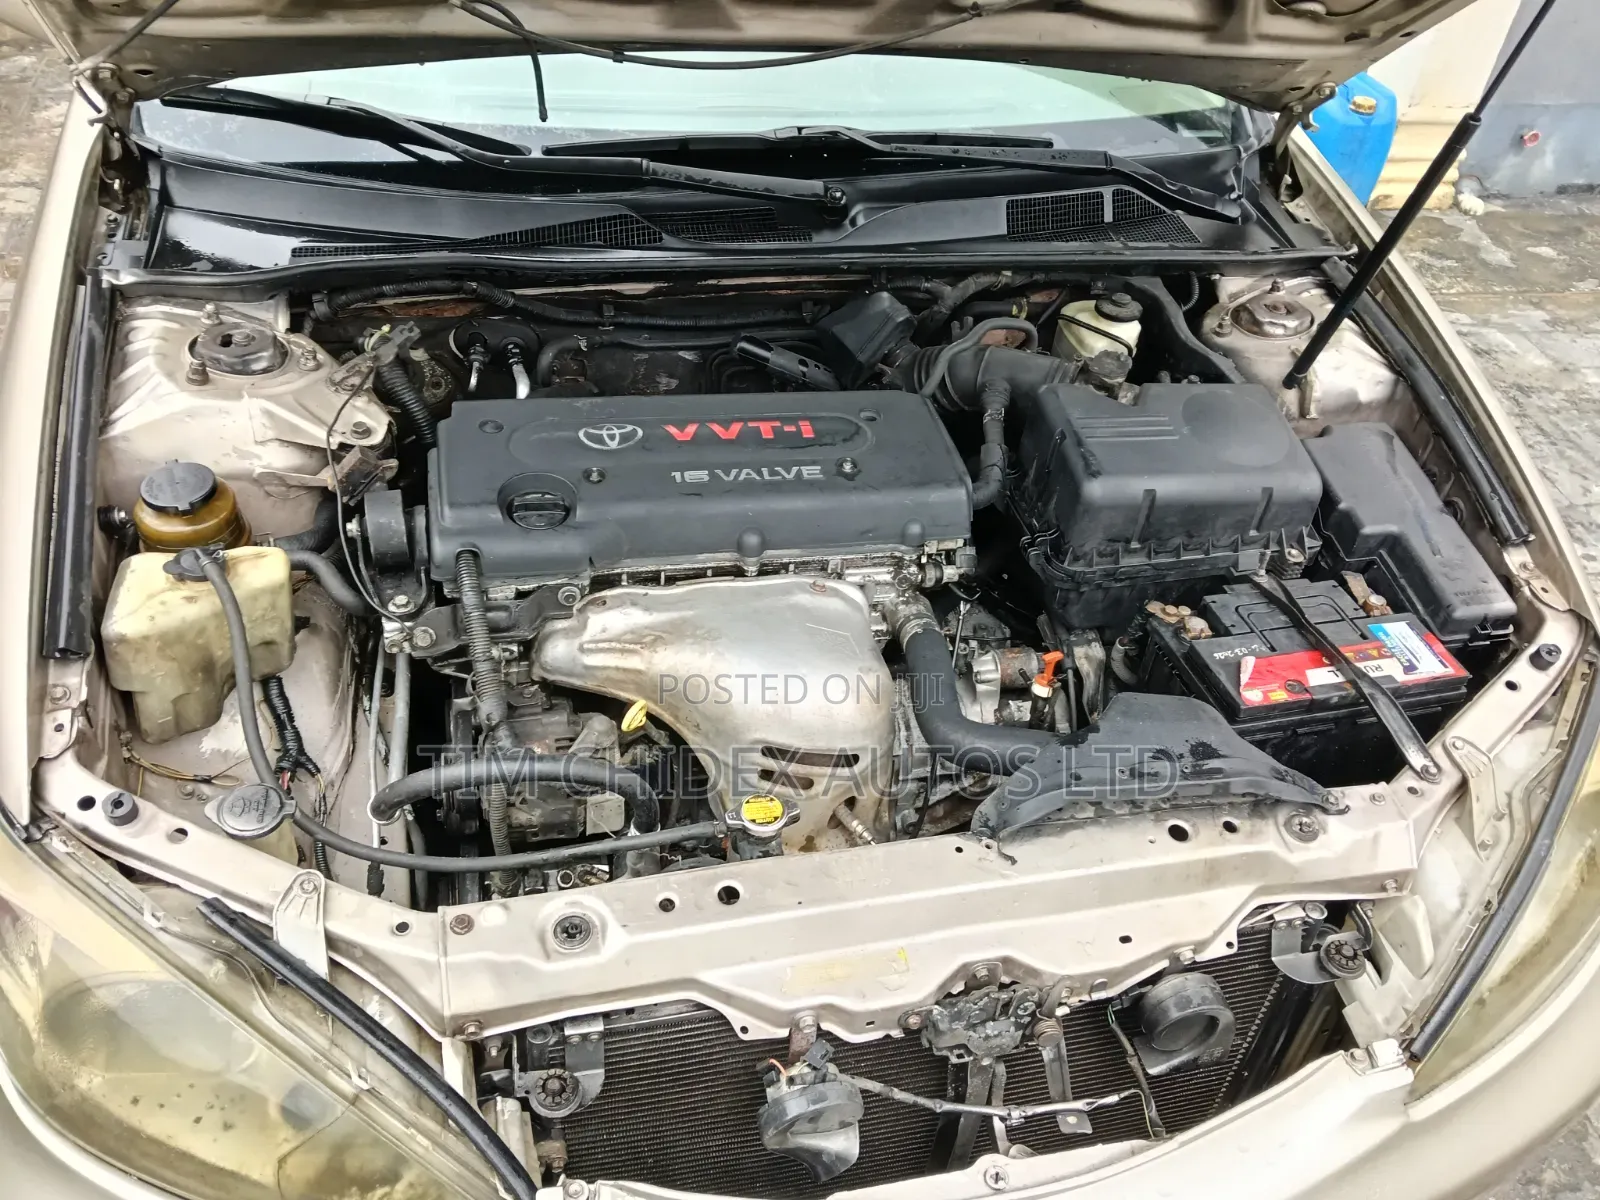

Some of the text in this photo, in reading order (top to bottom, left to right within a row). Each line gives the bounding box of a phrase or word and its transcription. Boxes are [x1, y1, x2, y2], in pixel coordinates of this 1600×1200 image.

[660, 419, 815, 441] VVT-i
[671, 465, 824, 483] 16 VALVE
